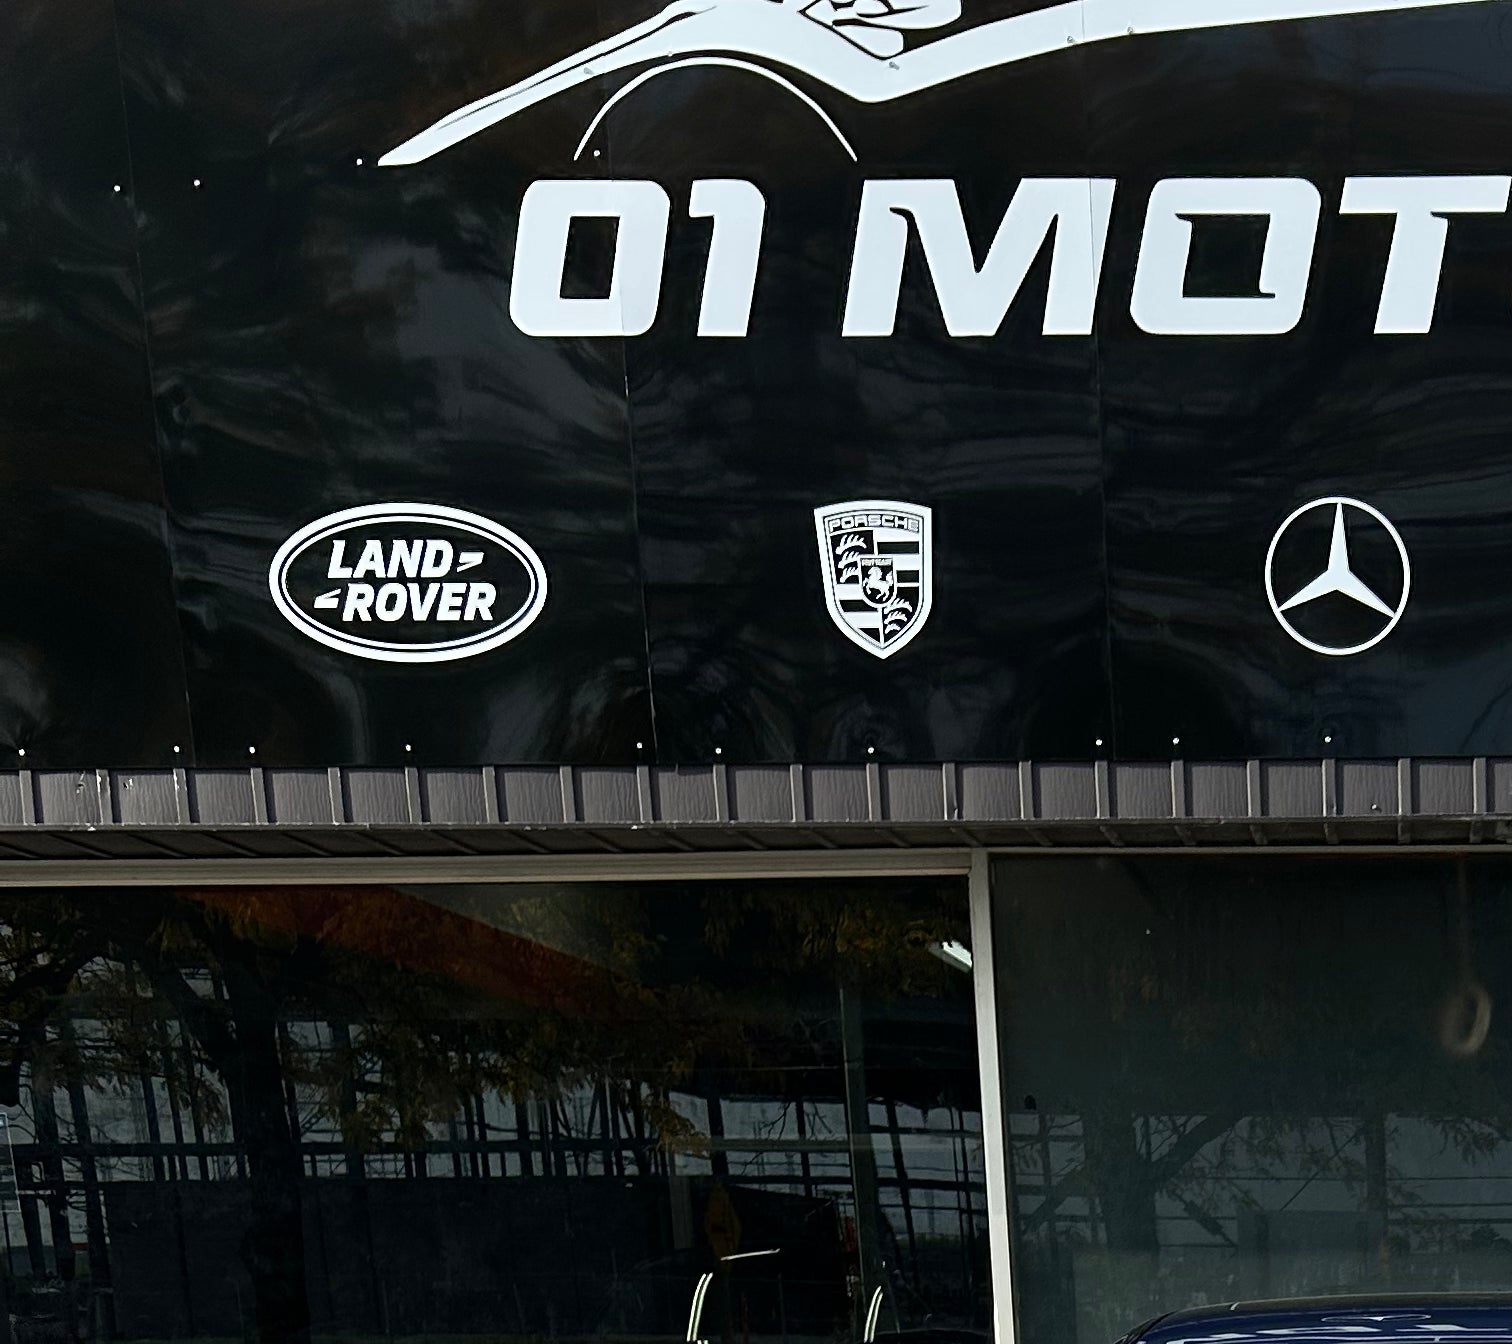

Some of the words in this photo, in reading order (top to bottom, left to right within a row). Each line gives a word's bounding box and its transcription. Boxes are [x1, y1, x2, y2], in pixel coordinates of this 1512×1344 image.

[510, 178, 765, 338] 01
[827, 514, 920, 534] PORSCHE
[328, 539, 454, 579] LAND
[342, 582, 497, 622] ROVER
